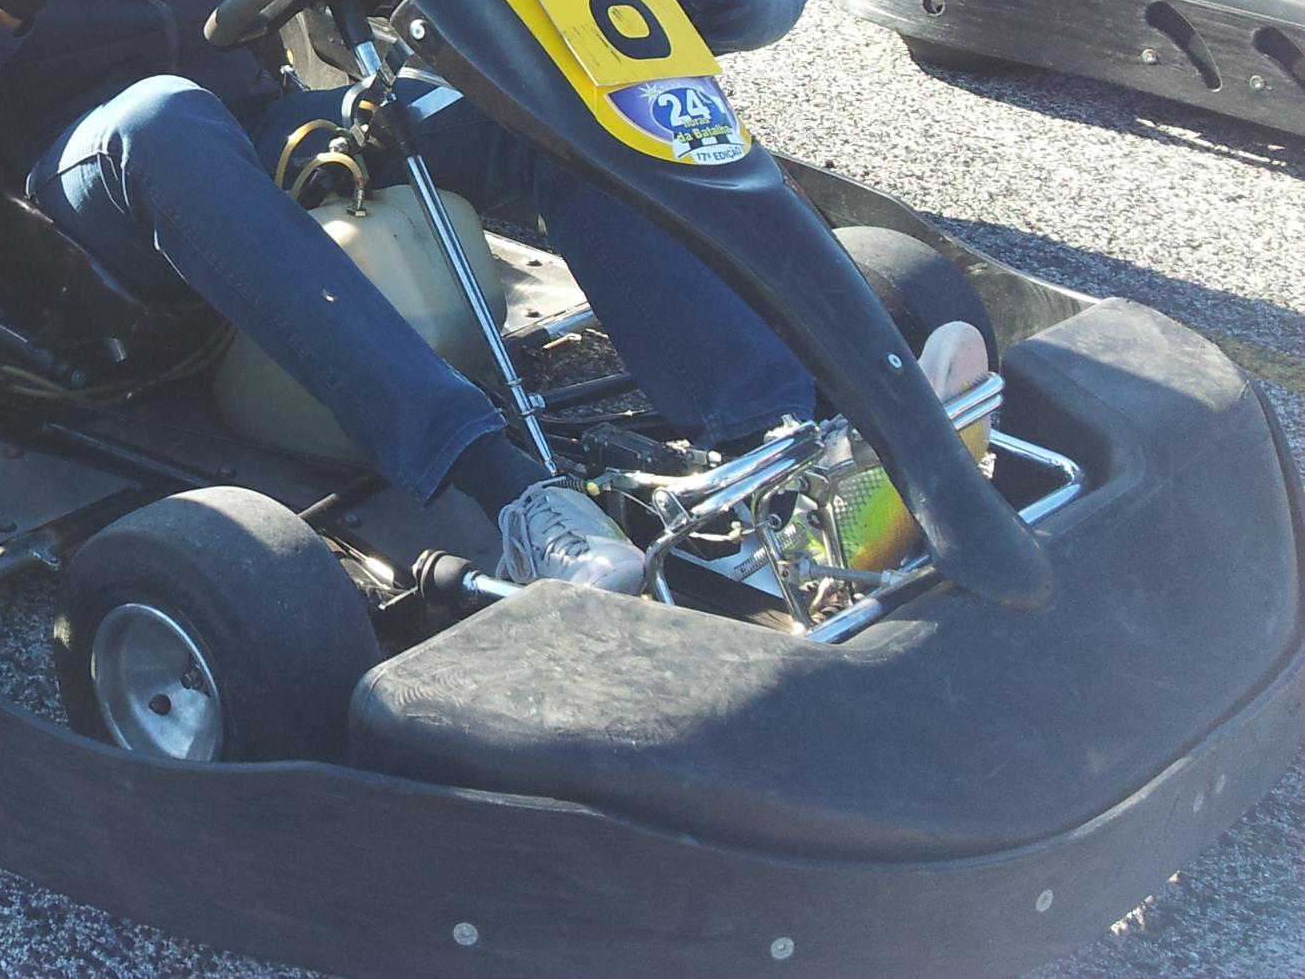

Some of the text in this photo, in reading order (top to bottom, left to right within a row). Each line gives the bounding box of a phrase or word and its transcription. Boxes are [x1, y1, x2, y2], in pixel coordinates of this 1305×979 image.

[658, 89, 711, 126] 24
[677, 124, 733, 143] da Batalha
[714, 145, 742, 161] EDIÇÃO
